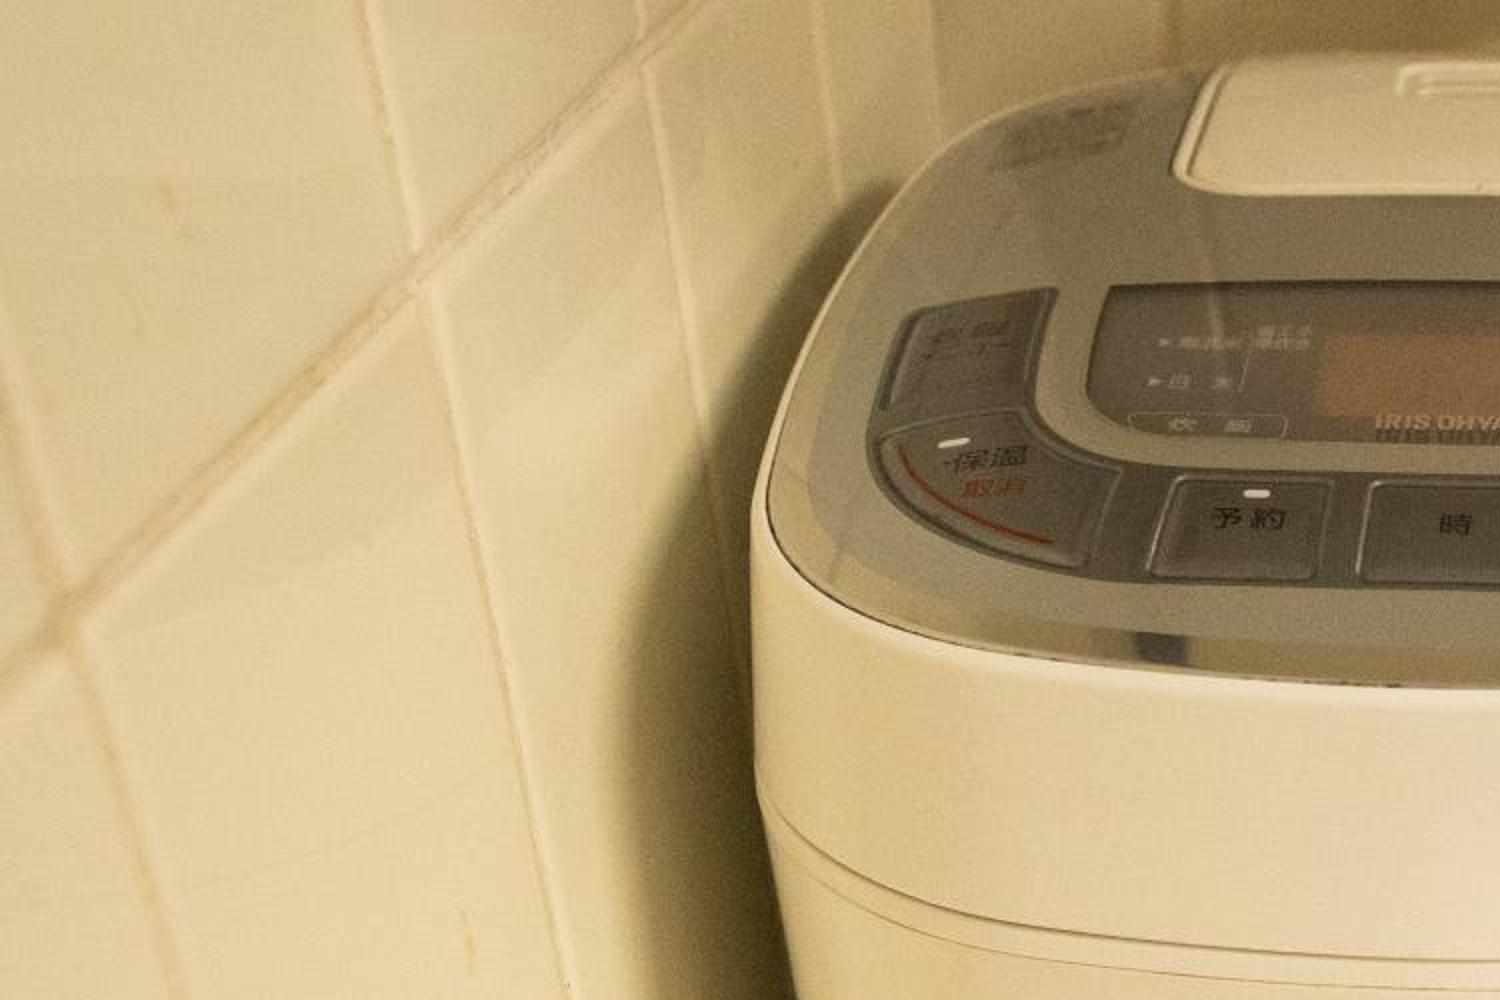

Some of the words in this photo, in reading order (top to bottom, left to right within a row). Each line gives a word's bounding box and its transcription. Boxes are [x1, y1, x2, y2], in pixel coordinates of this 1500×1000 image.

[1374, 414, 1430, 434] IRIS
[953, 446, 1028, 473] 保温
[1212, 506, 1287, 529] 予約
[1438, 513, 1472, 535] 時
